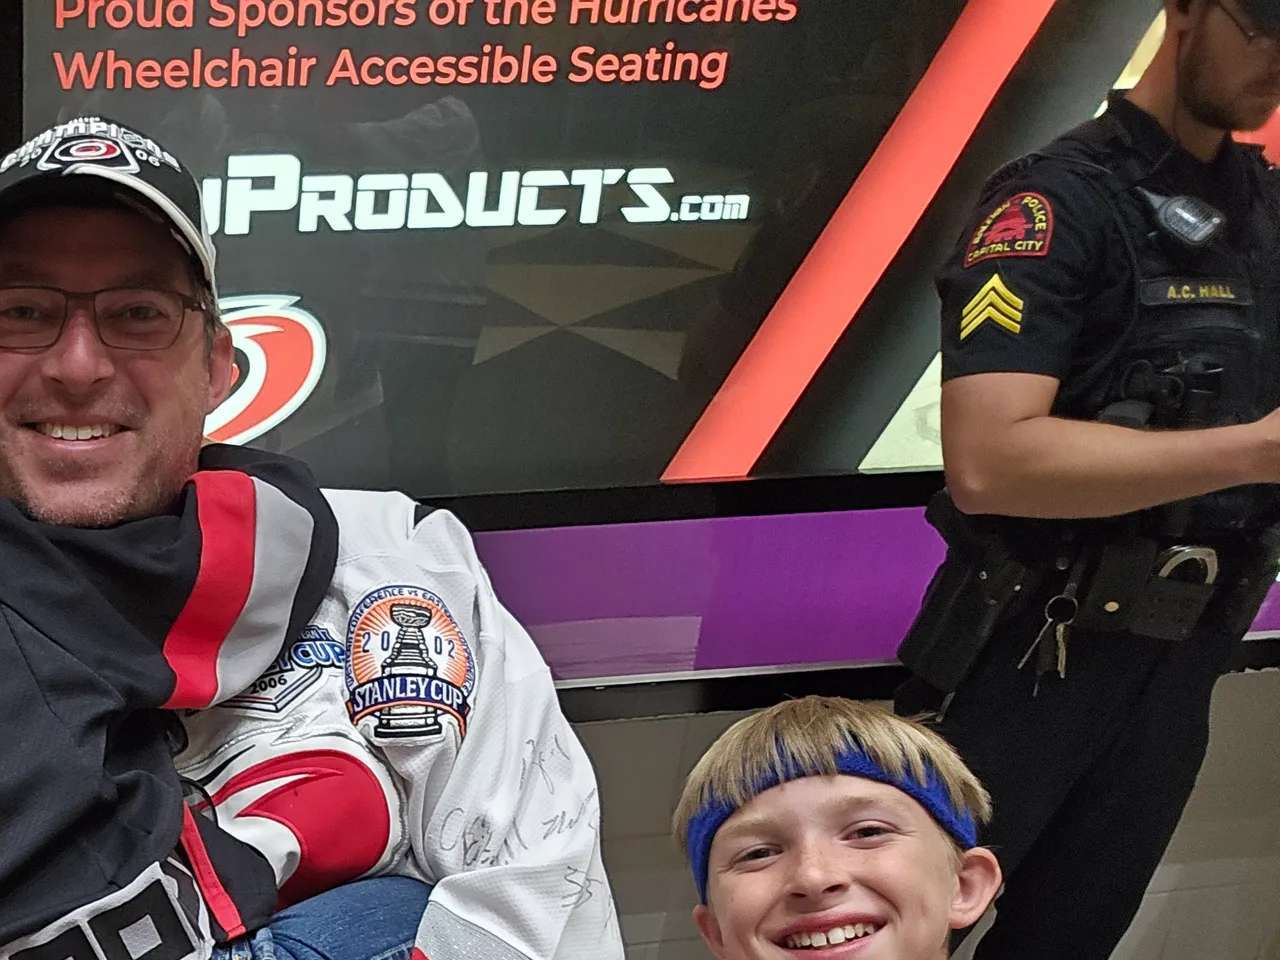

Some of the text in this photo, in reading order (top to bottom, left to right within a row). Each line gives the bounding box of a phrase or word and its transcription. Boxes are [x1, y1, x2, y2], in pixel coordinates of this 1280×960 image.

[55, 0, 799, 37] Proud Sponsors of the Hurricanes
[53, 41, 729, 90] Wheelchair Accessible Seating
[1021, 196, 1048, 232] POLICE
[1014, 240, 1044, 251] CITY
[1199, 285, 1236, 299] HALL
[353, 675, 463, 712] STANLEY CUP
